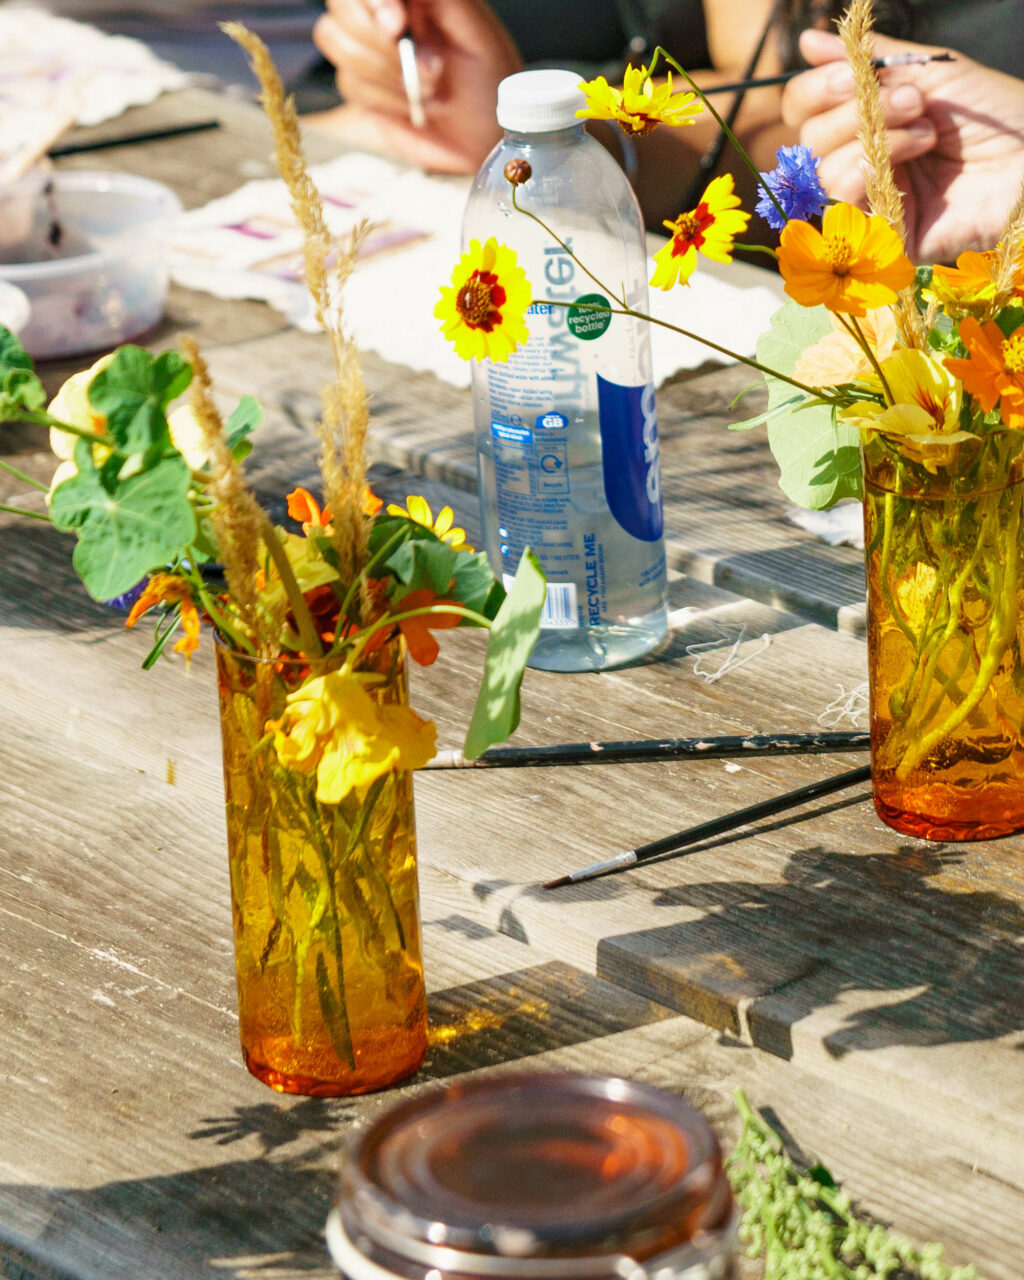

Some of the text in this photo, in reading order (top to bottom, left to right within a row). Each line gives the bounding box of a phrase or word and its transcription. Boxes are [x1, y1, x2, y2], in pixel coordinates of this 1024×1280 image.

[526, 303, 553, 315] ater
[568, 310, 610, 324] recycled
[542, 417, 564, 428] GB
[583, 533, 601, 626] RECYCLE ME
